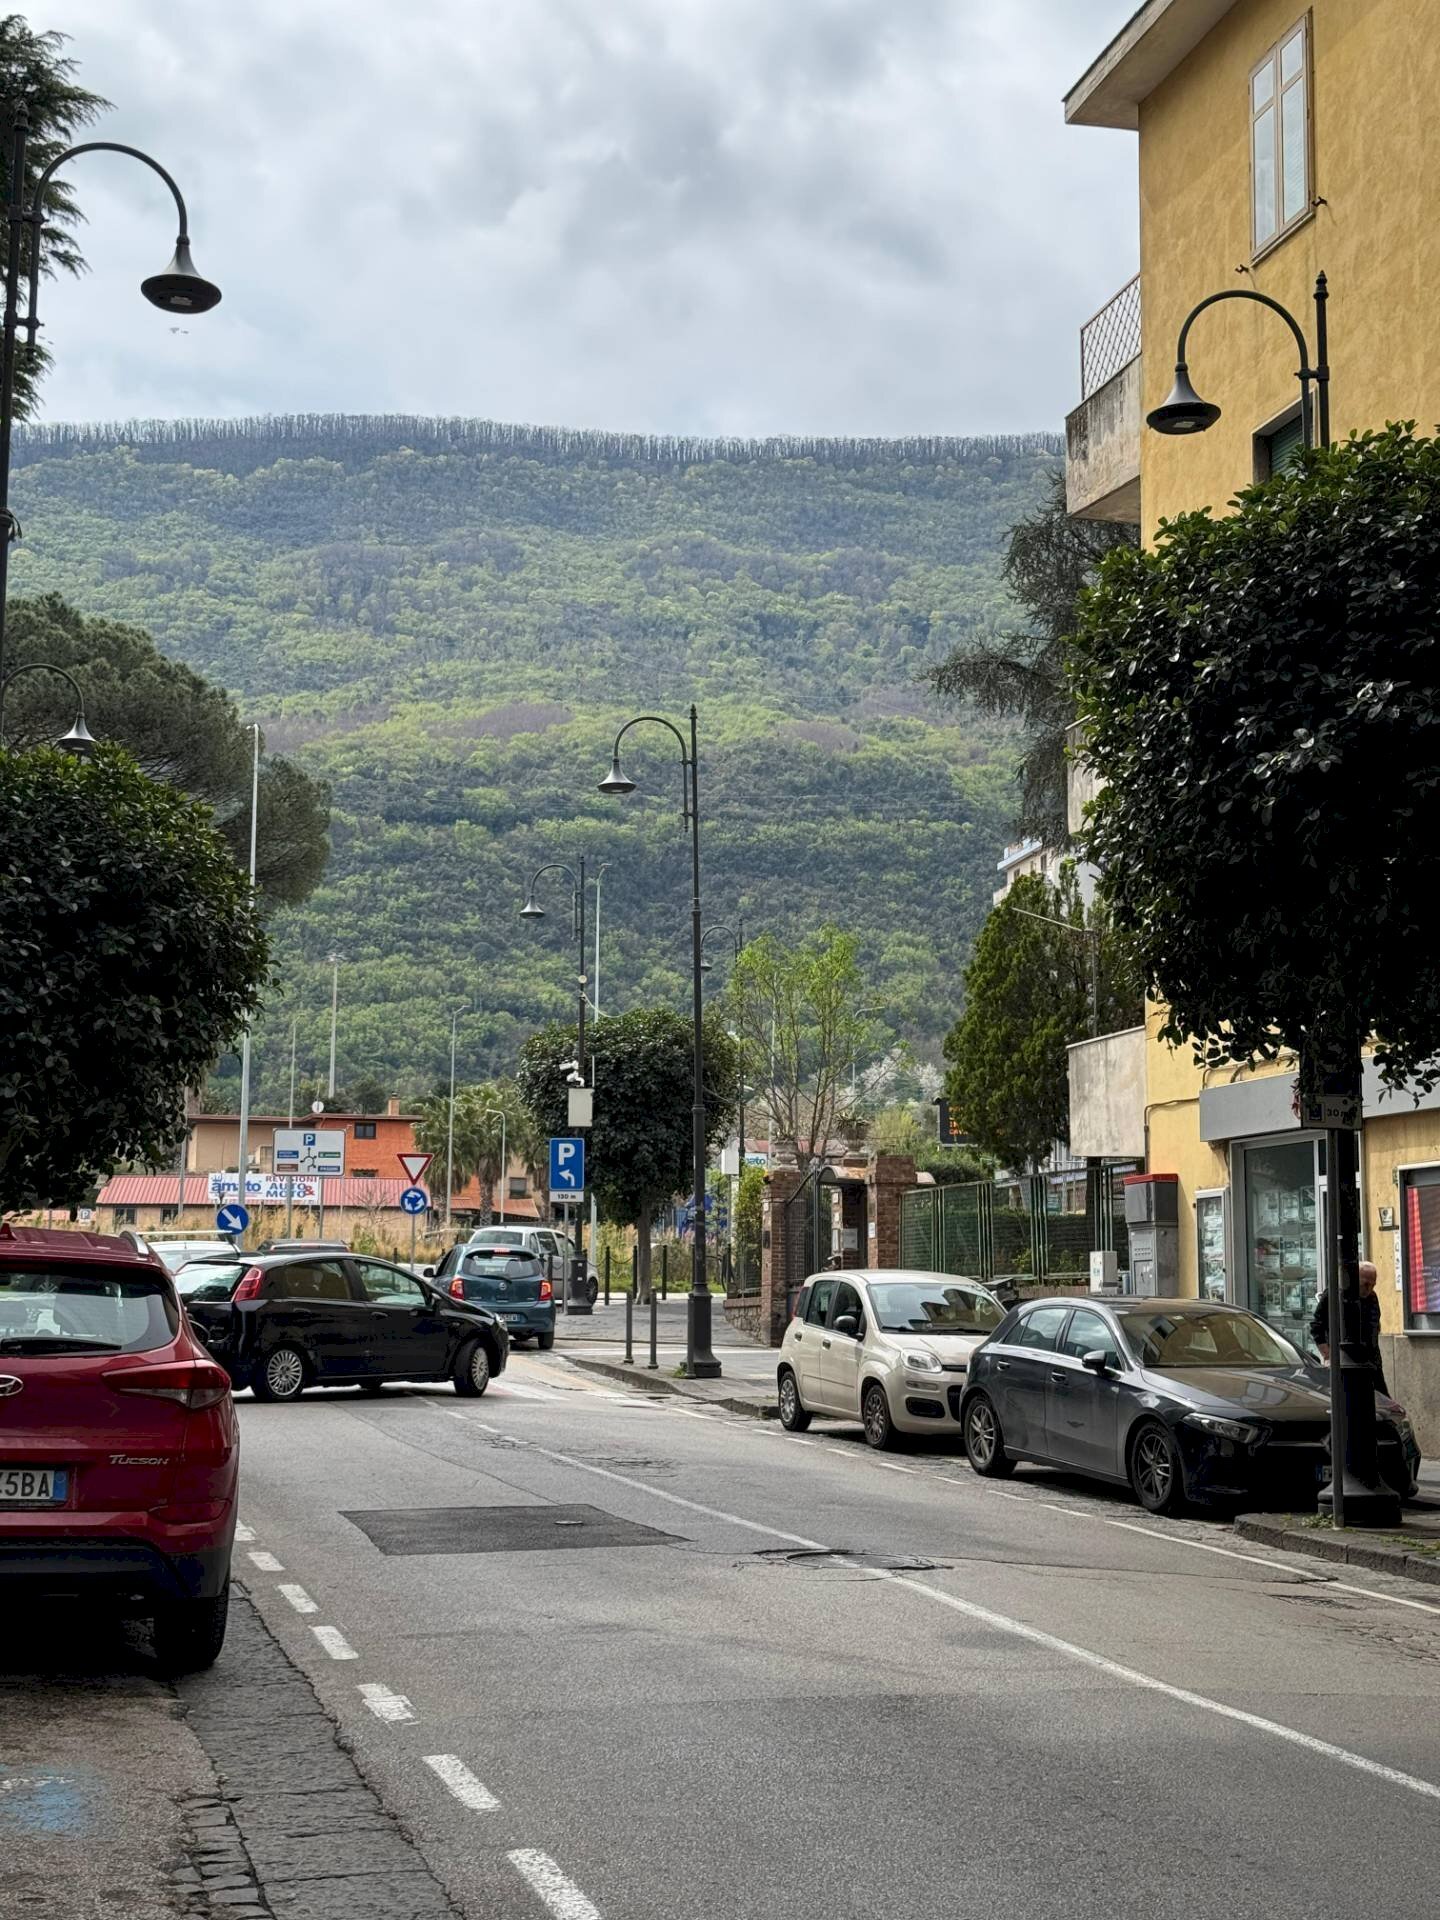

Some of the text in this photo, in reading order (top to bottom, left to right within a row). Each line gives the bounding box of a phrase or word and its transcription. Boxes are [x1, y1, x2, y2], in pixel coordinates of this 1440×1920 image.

[305, 1134, 314, 1145] P
[558, 1143, 576, 1166] P
[0, 1471, 51, 1498] 5BA
